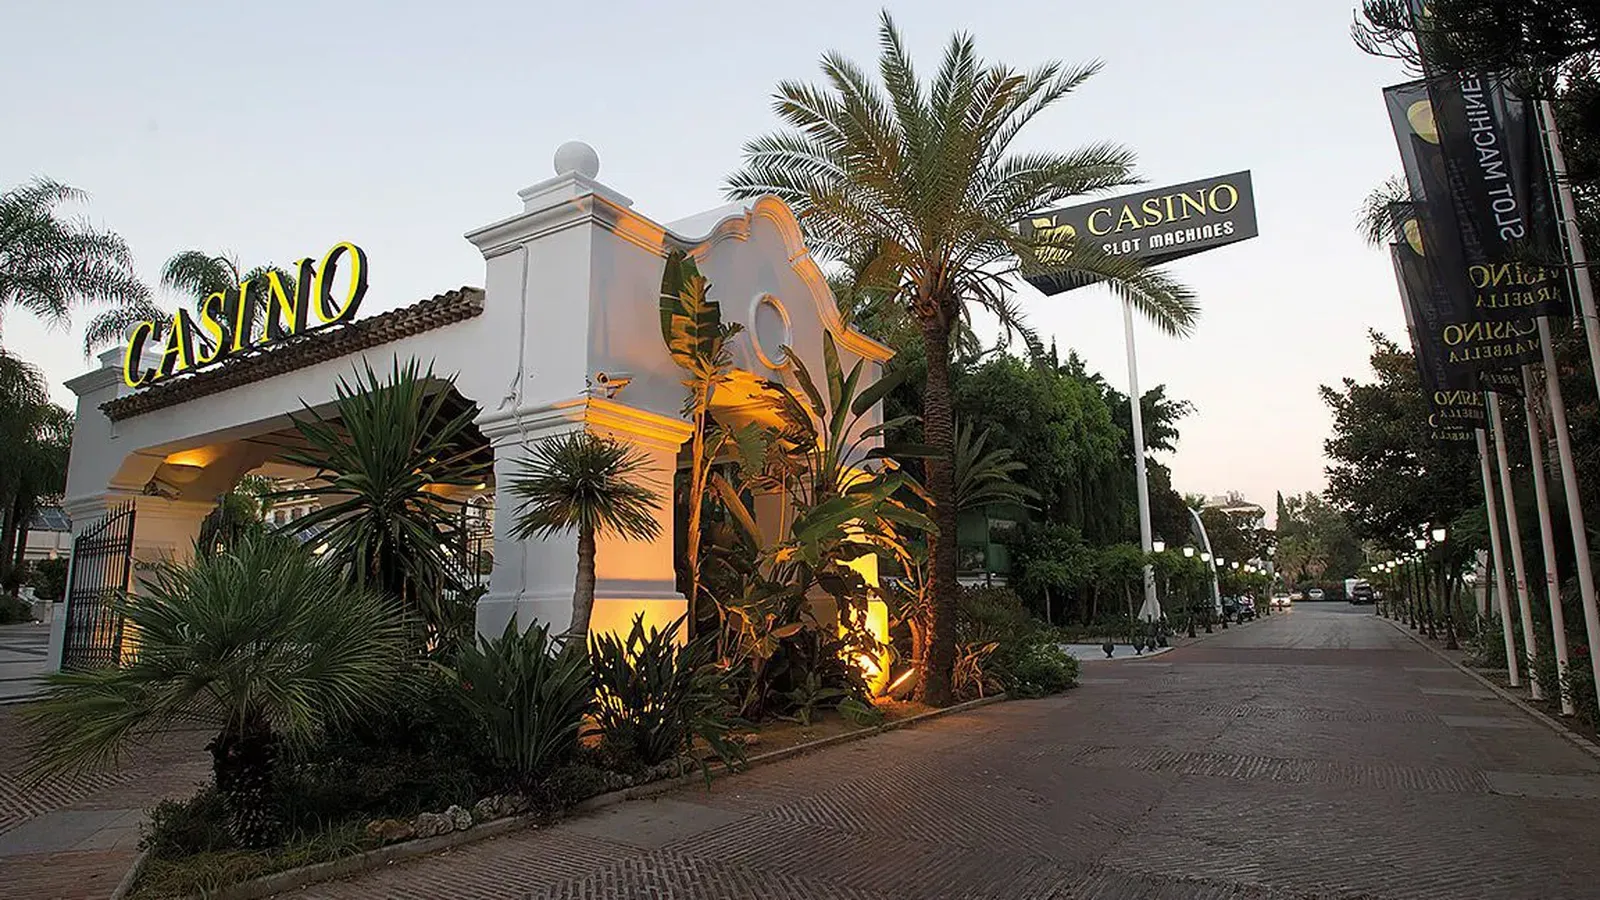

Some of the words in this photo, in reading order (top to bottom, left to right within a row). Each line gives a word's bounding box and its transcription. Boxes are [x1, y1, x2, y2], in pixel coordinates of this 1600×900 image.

[1087, 183, 1239, 236] CASINO
[1102, 238, 1141, 256] SLOT
[1149, 221, 1235, 249] MACHINES
[123, 241, 369, 388] CASINO
